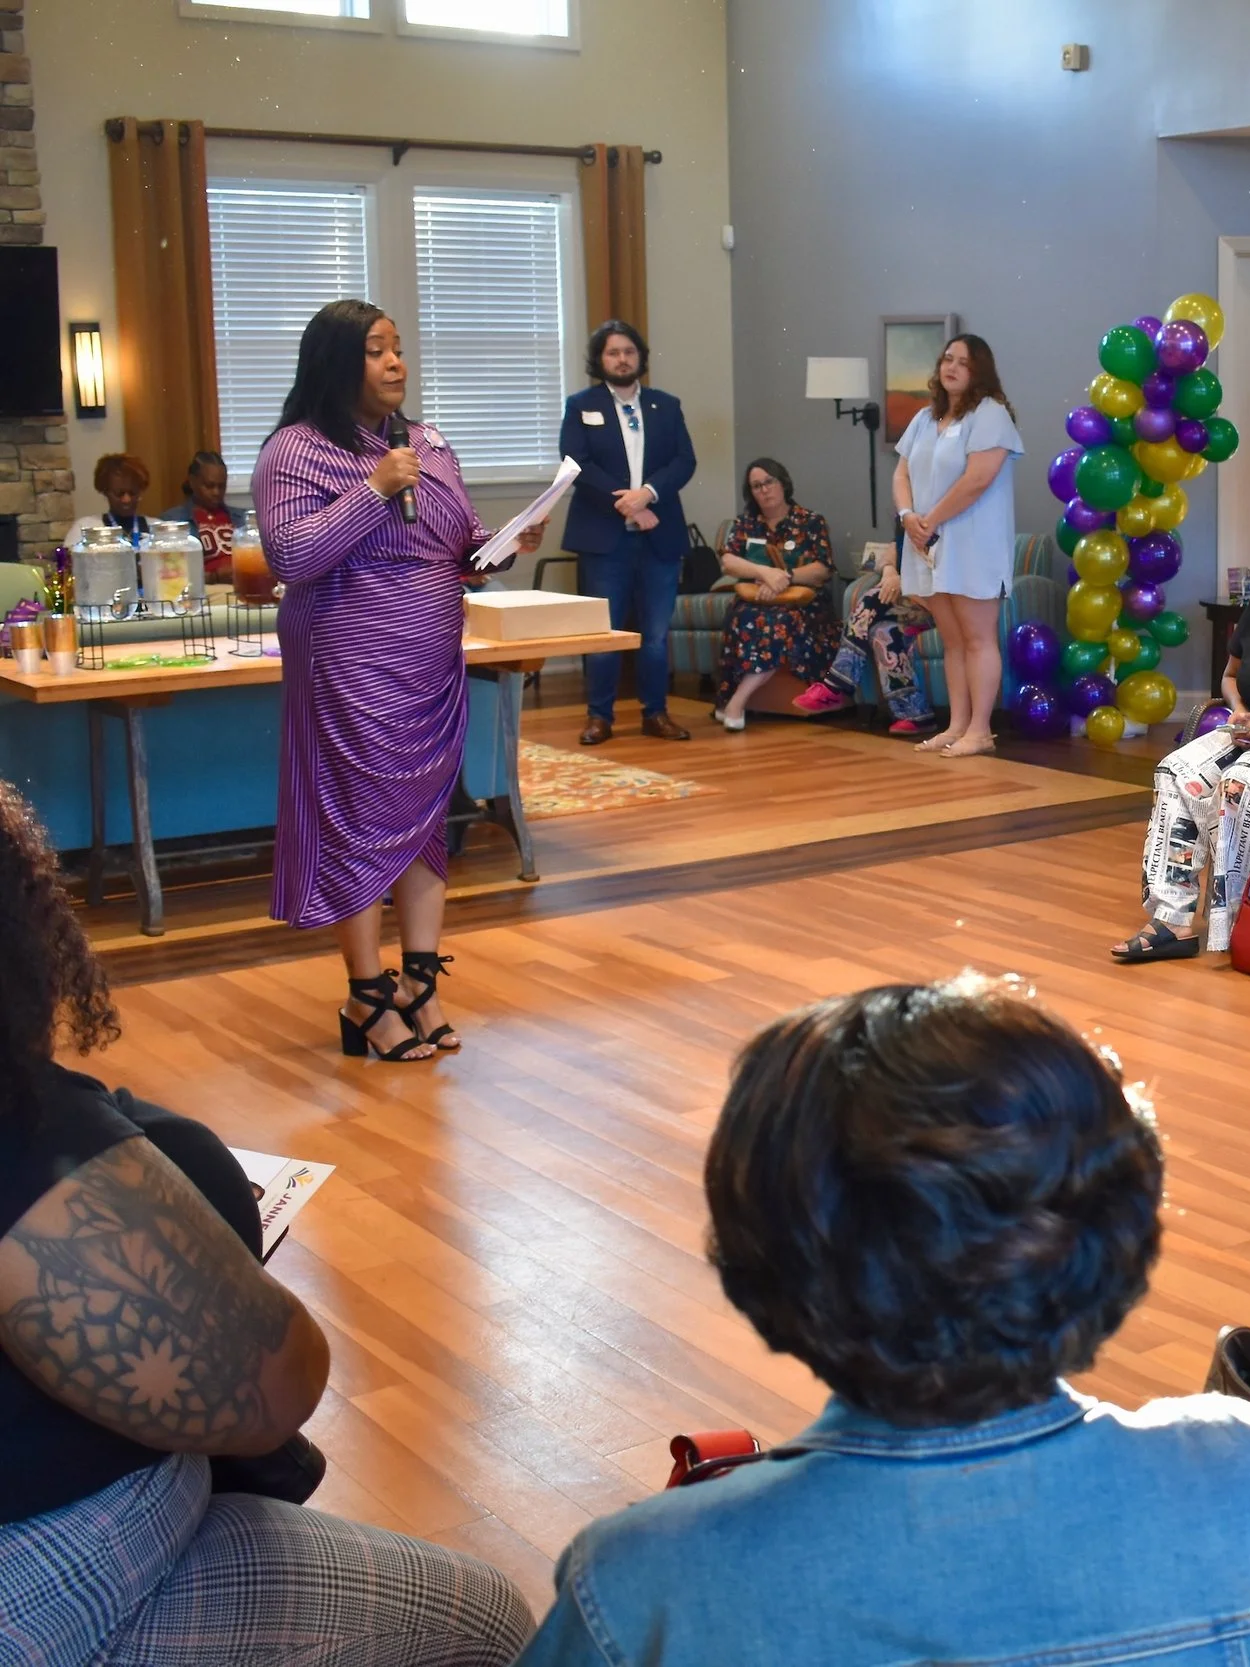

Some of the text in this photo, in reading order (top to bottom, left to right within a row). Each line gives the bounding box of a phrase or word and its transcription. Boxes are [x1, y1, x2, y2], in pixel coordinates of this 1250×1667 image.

[1149, 837, 1164, 883] EXPECTANT
[1158, 801, 1168, 834] BEAUTY
[1234, 830, 1249, 870] EXPECTANT
